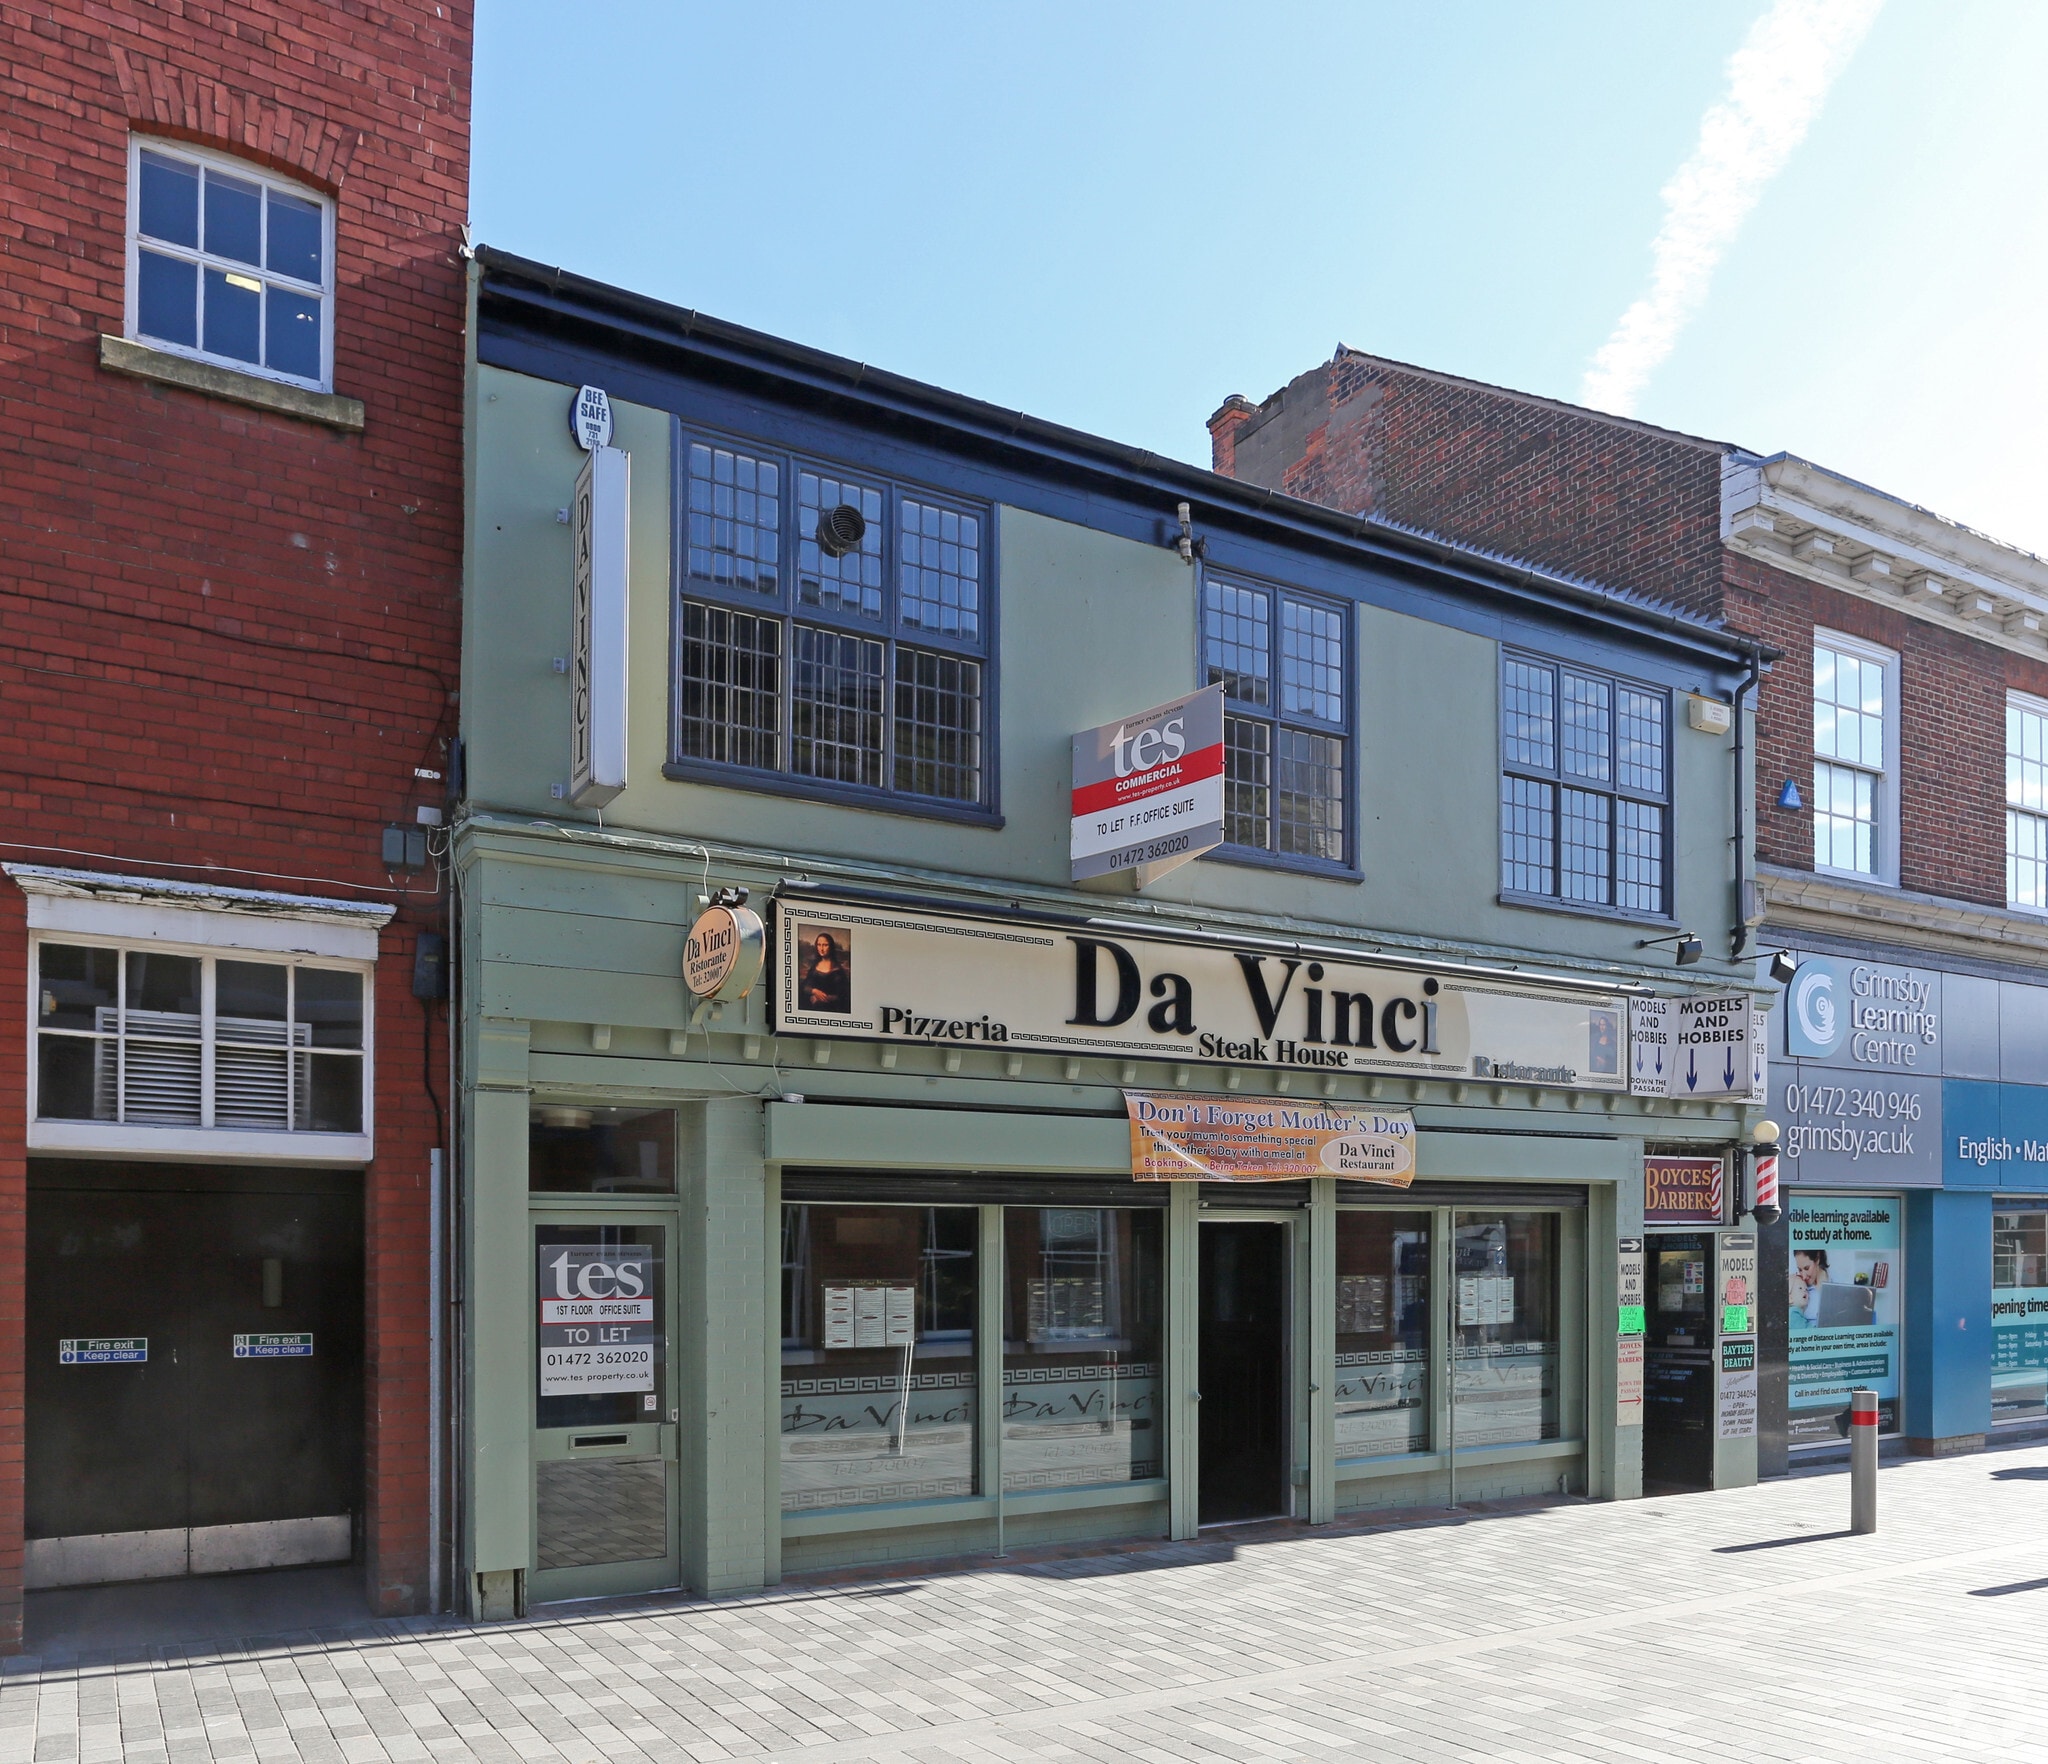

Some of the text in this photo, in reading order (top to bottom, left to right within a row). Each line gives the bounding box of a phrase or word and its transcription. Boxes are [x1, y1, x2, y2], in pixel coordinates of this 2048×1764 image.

[586, 390, 603, 405] BEE
[581, 403, 606, 422] SAFE
[1109, 717, 1186, 778] tes
[1115, 763, 1183, 793] COMMERCIAL
[1118, 779, 1180, 802] www.tes-property.co.uk
[1097, 798, 1194, 836] TO LET SUITE
[1110, 835, 1189, 869] 01472 362020
[687, 921, 732, 962] Da Vinci
[690, 952, 726, 975] Ristorante
[1065, 935, 1441, 1054] Da Vinci
[1851, 966, 1931, 1012] Grimsby
[1632, 1000, 1666, 1014] MODELS
[1680, 1000, 1742, 1014] MODELS
[879, 1006, 1009, 1042] Pizzeria
[1640, 1017, 1659, 1028] AND
[1694, 1015, 1728, 1028] AND
[1852, 998, 1937, 1044] Learning
[1630, 1030, 1667, 1045] HOBBIES
[1679, 1029, 1744, 1045] HOBBIES
[1199, 1032, 1349, 1067] Steak House
[1852, 1032, 1916, 1066] Centre
[1472, 1056, 1577, 1083] Ristorante
[1633, 1085, 1664, 1093] PASSAGE
[1786, 1083, 1921, 1121] 01472 340 946
[1137, 1100, 1410, 1139] Don't Forget Mother's Day
[1167, 1131, 1190, 1141] your
[1193, 1132, 1217, 1140] mum
[1221, 1132, 1229, 1141] to
[1233, 1133, 1282, 1146] something
[1285, 1136, 1316, 1146] special
[1788, 1120, 1914, 1161] grimsby.ac.uk
[1217, 1145, 1236, 1158] Day
[1241, 1147, 1260, 1157] with
[1272, 1149, 1294, 1158] meal
[1296, 1151, 1305, 1159] at
[1339, 1142, 1395, 1158] Da Vinci
[1959, 1136, 2012, 1166] English
[1145, 1157, 1188, 1169] Bookings
[1210, 1161, 1234, 1172] Being
[1237, 1162, 1263, 1171] Taken
[1301, 1165, 1317, 1173] 007
[1340, 1158, 1395, 1170] Restaurant
[1645, 1168, 1711, 1192] BOYCES
[1645, 1185, 1712, 1210] BARBERS
[1811, 1209, 1890, 1226] learning available
[1793, 1227, 1872, 1244] to study at home.
[1621, 1264, 1640, 1275] MODELS
[1722, 1259, 1753, 1271] MODELS
[550, 1251, 644, 1299] tes
[1625, 1279, 1636, 1290] AND
[1620, 1294, 1640, 1305] HOBBIES
[557, 1304, 640, 1315] 1ST FLOOR OFFICE SUITE
[1992, 1299, 2026, 1319] pening
[259, 1336, 300, 1345] Fire exit
[564, 1327, 631, 1343] TO LET
[89, 1340, 134, 1350] Fire exit
[255, 1346, 304, 1355] Keep clear
[1723, 1345, 1753, 1355] BAYTREE
[84, 1351, 138, 1360] Keep clear
[547, 1351, 648, 1366] 01472 362020
[1724, 1357, 1752, 1368] BEAUTY
[1359, 1372, 1425, 1394] Vinci
[1720, 1392, 1735, 1400] 01472
[1795, 1389, 1804, 1397] Call
[1810, 1388, 1819, 1396] and
[1003, 1389, 1155, 1418] Da Vinci
[783, 1400, 971, 1432] Da Vnci
